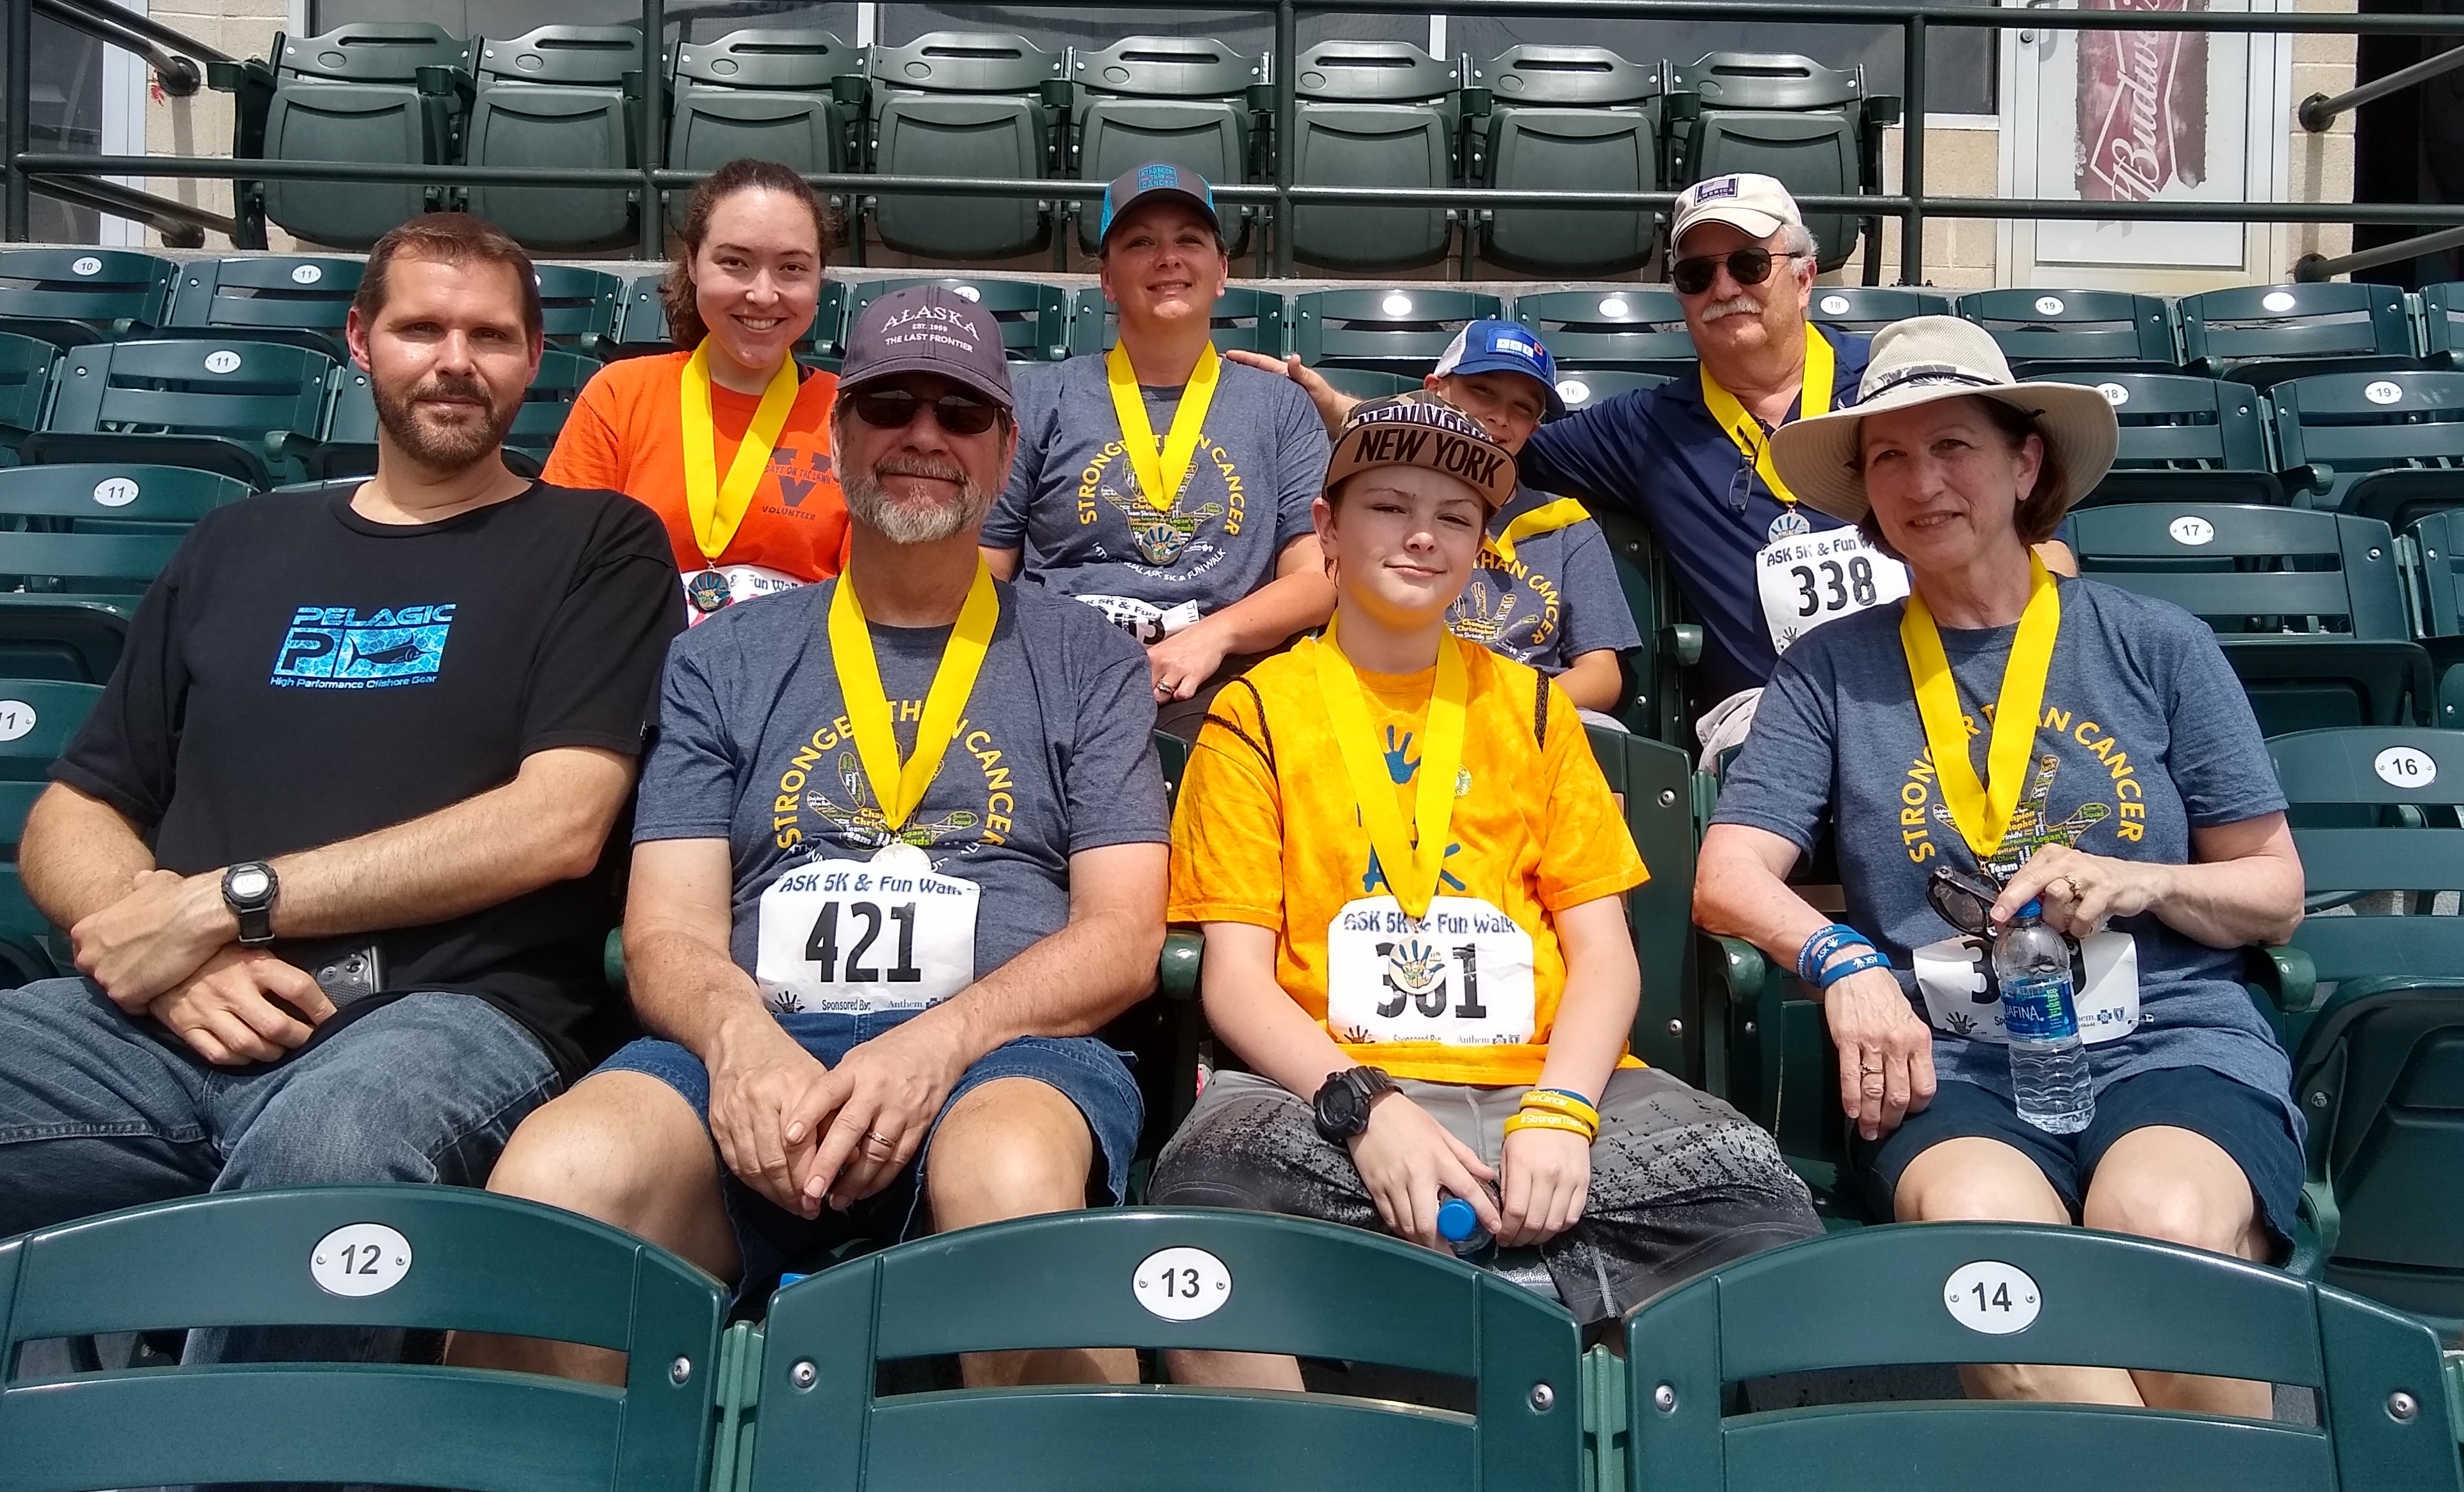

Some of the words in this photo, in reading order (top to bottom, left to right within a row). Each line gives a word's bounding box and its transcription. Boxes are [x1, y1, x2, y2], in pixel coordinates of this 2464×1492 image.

[80, 261, 94, 272] 10
[300, 269, 313, 279] 11
[2043, 301, 2056, 311] 19
[880, 305, 980, 341] ALASKA
[929, 323, 948, 332] 1959
[885, 335, 902, 345] THE
[904, 333, 928, 342] LAST
[929, 333, 973, 353] FRONTIER
[215, 356, 230, 369] 11
[1564, 387, 1578, 397] 16
[2104, 388, 2118, 400] 18
[2375, 386, 2392, 399] 19
[1353, 428, 1429, 463] NEW
[1432, 432, 1506, 489] YORK
[764, 464, 784, 474] DAYS
[786, 466, 797, 476] ON
[799, 469, 811, 479] THE
[812, 472, 830, 485] LAWN
[108, 484, 126, 499] 11
[1078, 439, 1128, 525] STRONG
[1211, 446, 1245, 536] CANCER
[762, 506, 816, 521] VOLUNTEER
[2182, 523, 2200, 537] 17
[1767, 547, 1793, 567] ASK
[1817, 542, 1830, 557] &
[1833, 538, 1856, 552] Fun
[1143, 569, 1162, 578] ASK
[1163, 573, 1177, 581] 5K
[1186, 563, 1206, 580] FUN
[1204, 548, 1227, 570] WALK
[1790, 556, 1877, 617] 338
[1118, 601, 1131, 610] &
[1528, 574, 1559, 645] CANCER
[293, 603, 456, 627] PELAGIC
[270, 676, 294, 687] High
[296, 678, 363, 689] Performance
[366, 678, 410, 689] Offshore
[411, 675, 438, 684] Gear
[2392, 757, 2418, 776] 16
[773, 715, 855, 849] STRONGE
[965, 730, 1014, 846] CANCER
[1900, 714, 1981, 864] STRONR
[2074, 720, 2146, 842] CANCER
[901, 830, 930, 838] ogan's
[2002, 831, 2023, 841] rinidhi
[2032, 831, 2068, 844] Logan's
[1995, 845, 2021, 856] rgettable
[1988, 863, 2018, 874] Team
[779, 873, 820, 892] ASK
[824, 872, 850, 891] 5K
[854, 874, 873, 891] &
[880, 875, 915, 893] Fun
[1343, 910, 1381, 933] ASK
[1386, 911, 1408, 934] 5K
[1438, 912, 1469, 934] Fun
[1473, 912, 1516, 934] Walk
[805, 901, 921, 983] 421
[1817, 946, 1830, 962] ASK
[1865, 955, 1878, 965] ASK
[822, 998, 858, 1011] Sponsored
[859, 1000, 871, 1011] By:
[887, 1000, 923, 1009] Anthem
[1457, 1035, 1489, 1044] Anthem
[340, 1244, 382, 1275] 12
[1160, 1268, 1200, 1300] 13
[1971, 1282, 2013, 1313] 14
